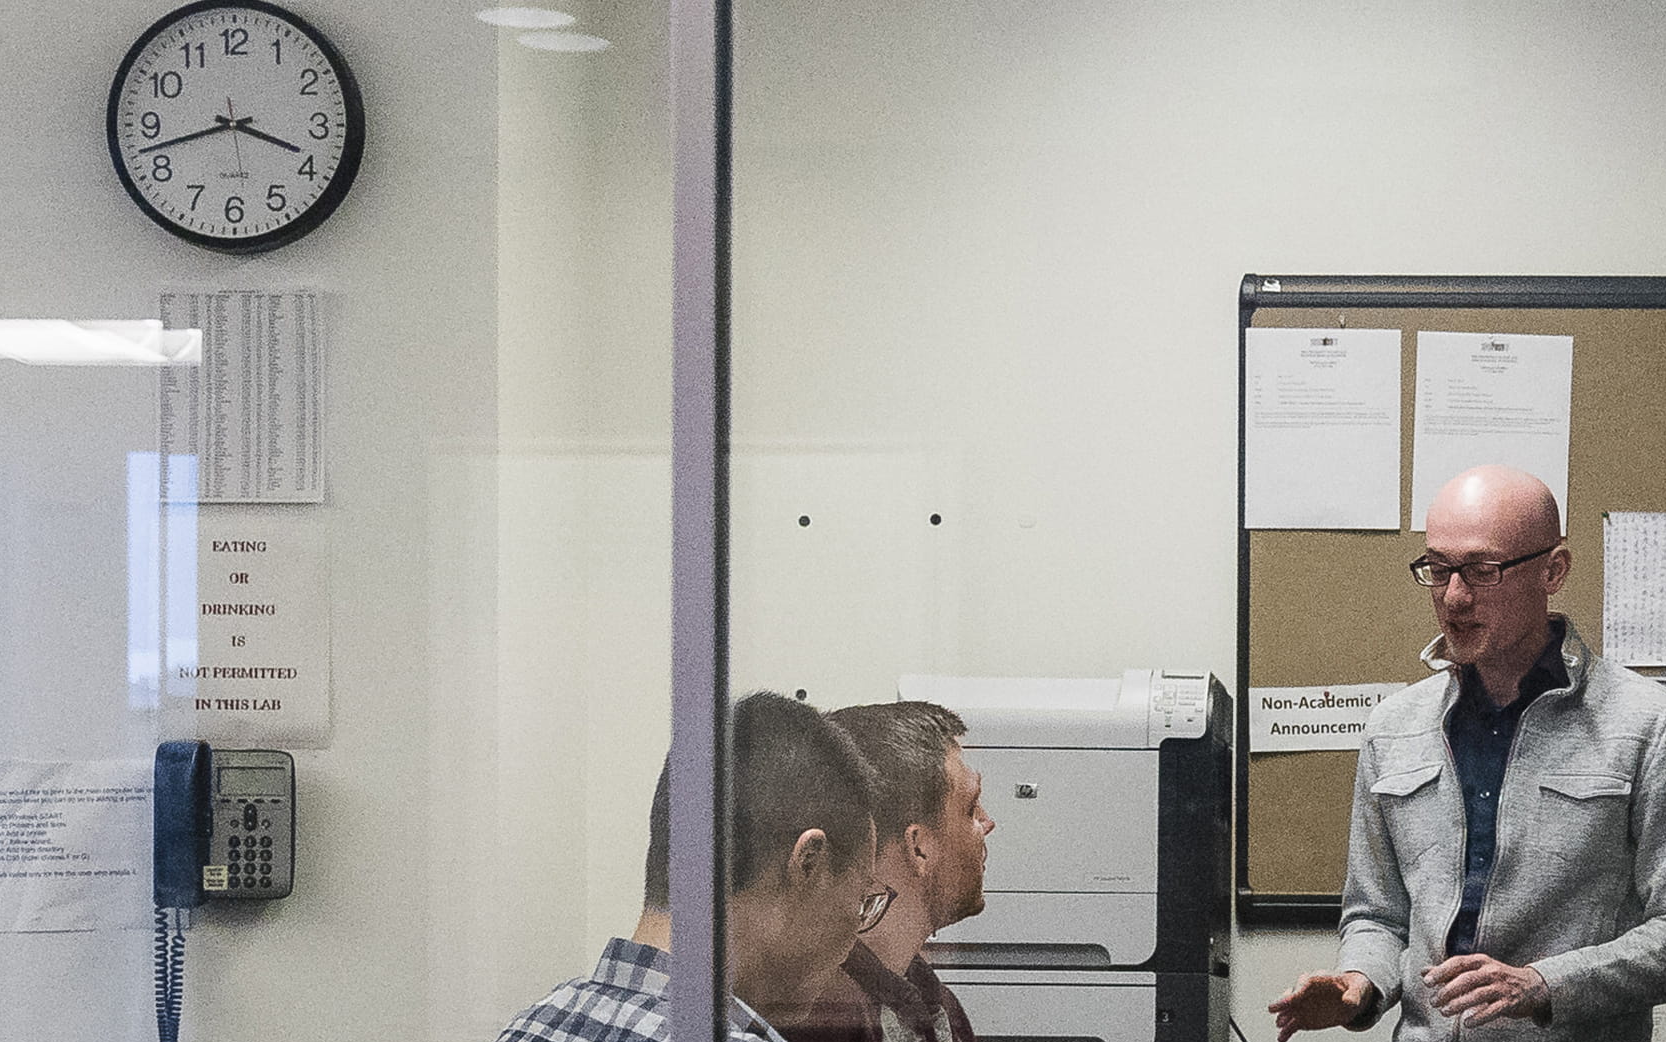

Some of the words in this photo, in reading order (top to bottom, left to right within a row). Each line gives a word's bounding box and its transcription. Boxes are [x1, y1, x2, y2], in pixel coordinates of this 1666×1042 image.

[219, 28, 249, 56] 12
[272, 39, 282, 65] 1
[181, 42, 205, 69] 11
[149, 71, 183, 98] 10
[299, 68, 319, 96] 2
[141, 111, 161, 139] 9
[308, 112, 329, 140] 3
[152, 155, 173, 182] 8
[297, 155, 317, 182] 4
[187, 185, 205, 211] 7
[225, 196, 245, 223] 6
[266, 185, 286, 211] 5
[212, 541, 267, 552] EATING
[229, 573, 249, 584] OR
[202, 604, 276, 616] DRINKING
[231, 636, 246, 647] IS
[179, 666, 211, 679] NOT
[213, 667, 298, 680] PERMITTED
[195, 699, 211, 711] IN
[215, 699, 250, 711] THIS
[253, 699, 281, 711] LAB
[1262, 694, 1372, 711] Non-Academic
[1271, 721, 1366, 735] Announcem
